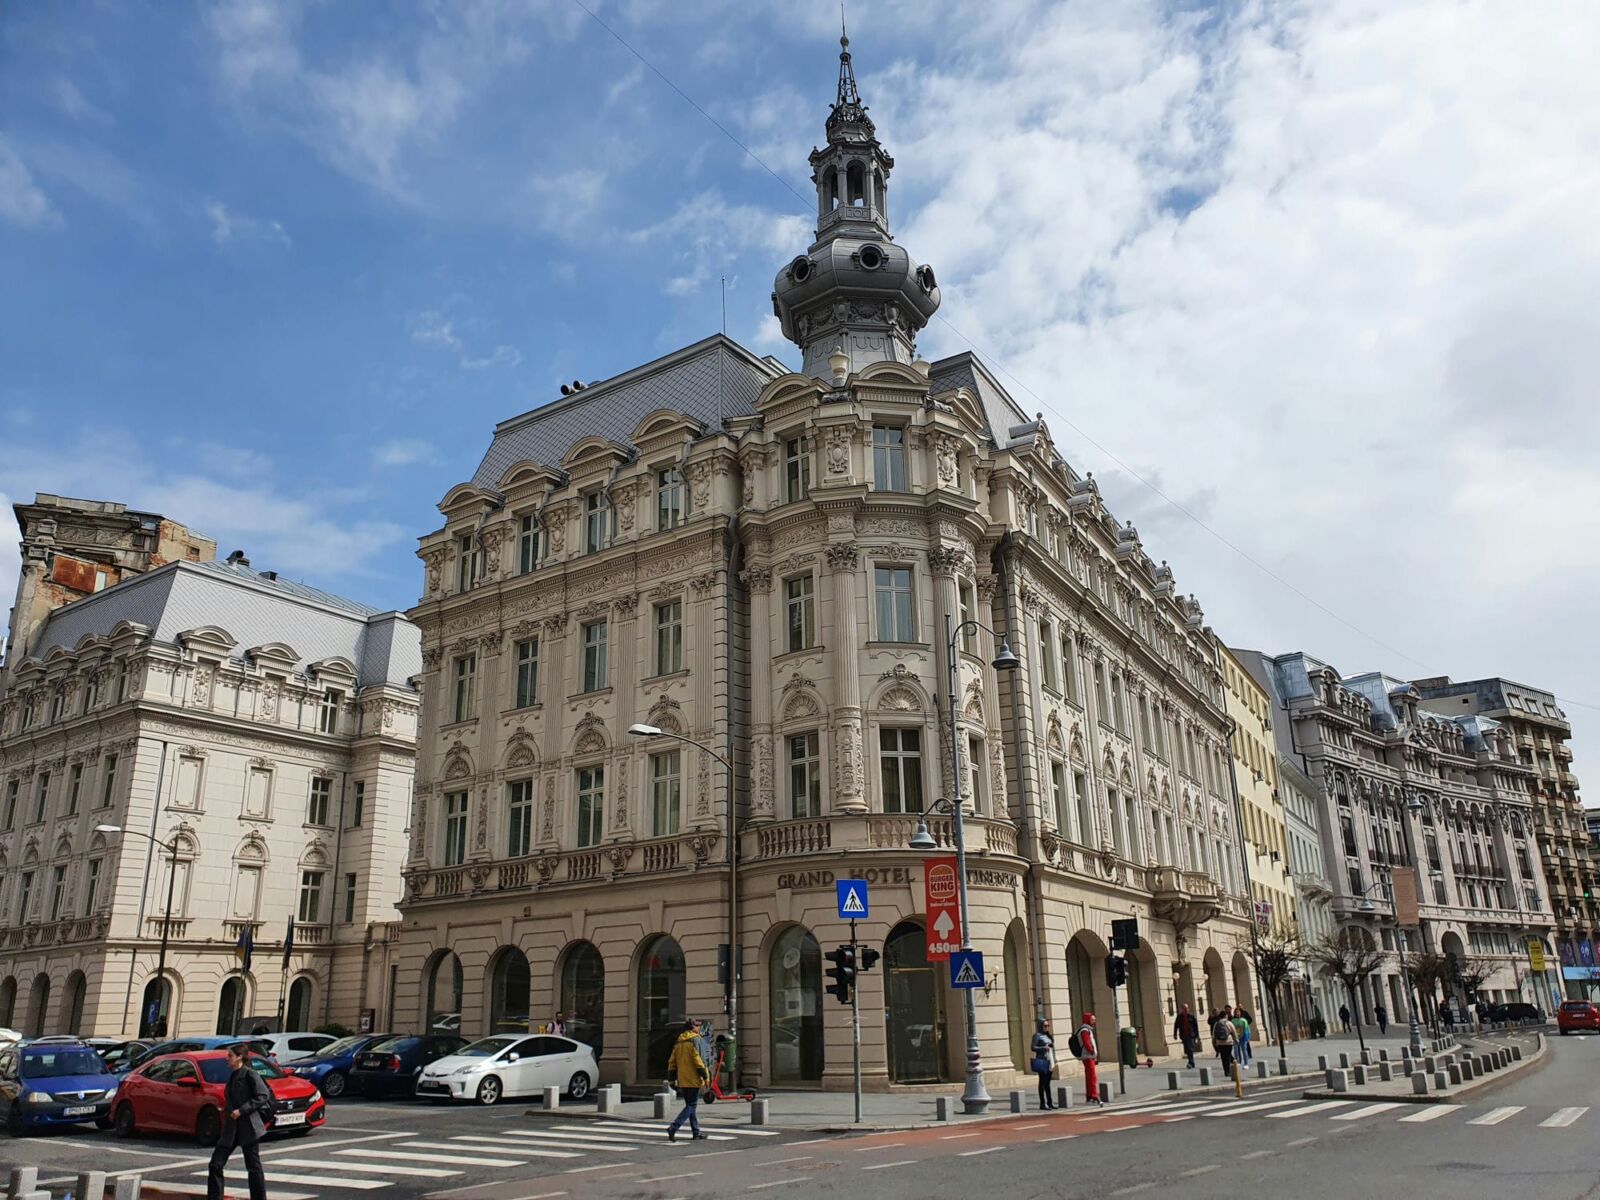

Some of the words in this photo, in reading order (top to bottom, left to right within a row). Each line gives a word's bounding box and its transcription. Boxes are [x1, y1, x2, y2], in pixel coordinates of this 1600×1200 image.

[777, 871, 835, 889] GRAND
[849, 867, 916, 884] HOTEL
[930, 882, 954, 892] KING
[929, 942, 960, 953] 450m
